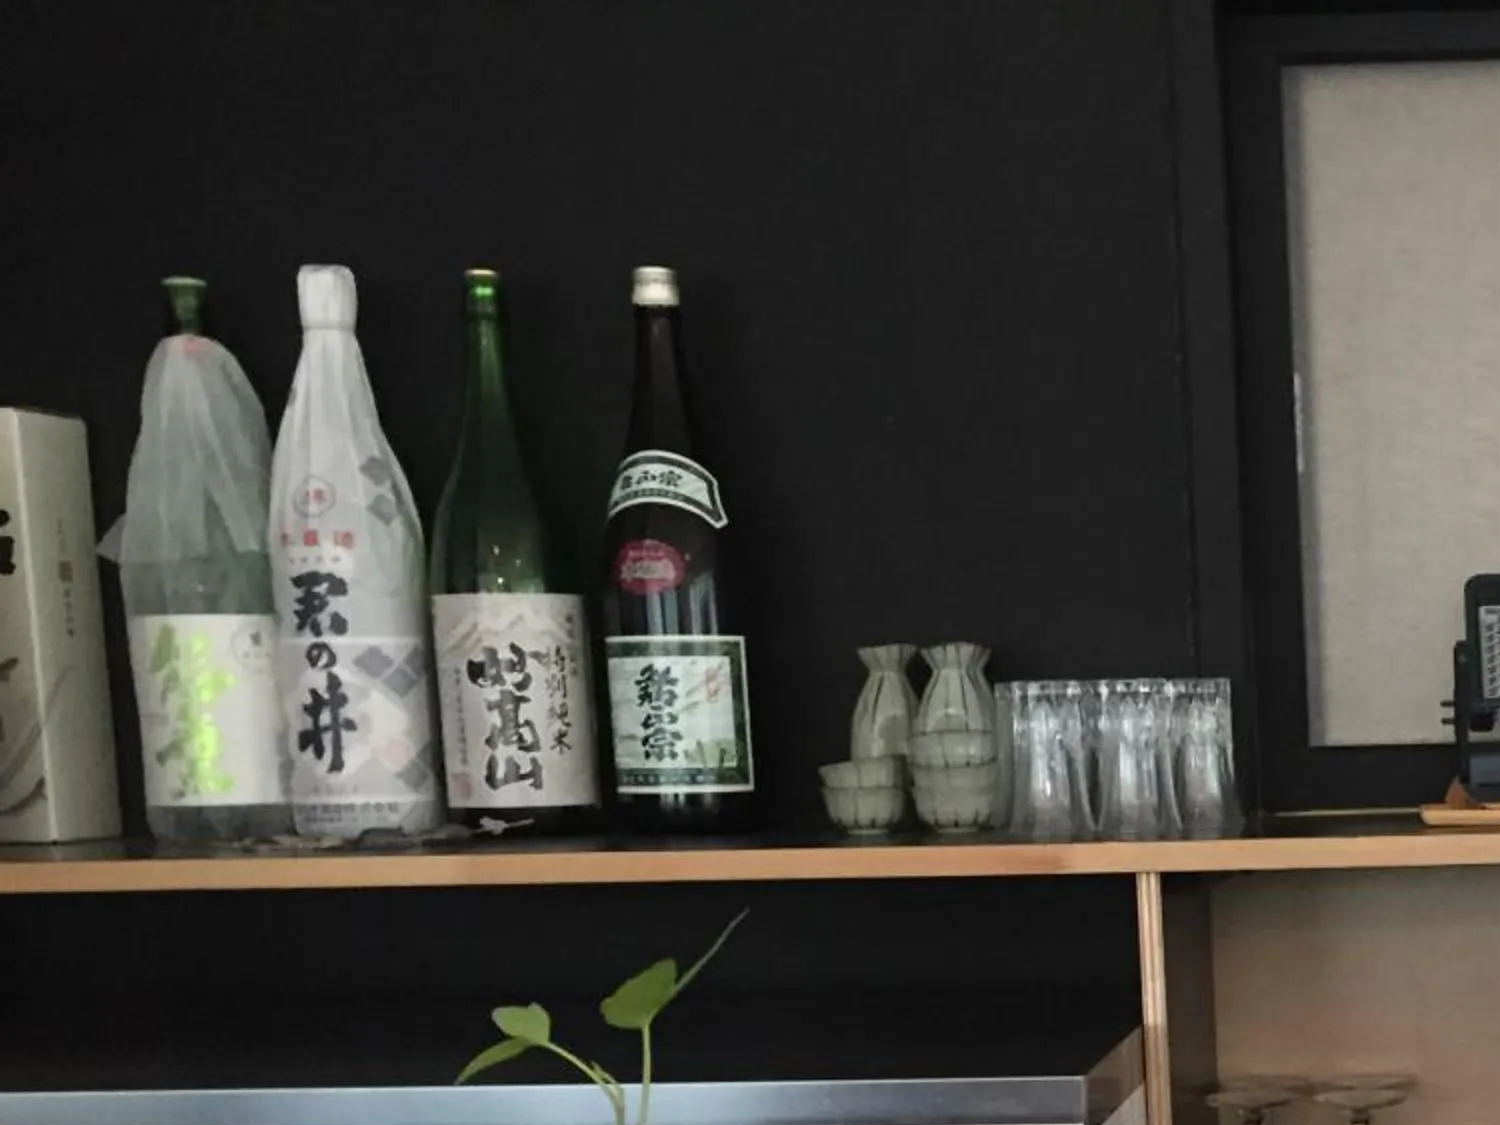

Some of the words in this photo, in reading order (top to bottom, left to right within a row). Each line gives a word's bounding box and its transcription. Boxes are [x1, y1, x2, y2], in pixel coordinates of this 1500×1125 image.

[289, 570, 358, 774] 君の井
[466, 641, 547, 791] 妙高山
